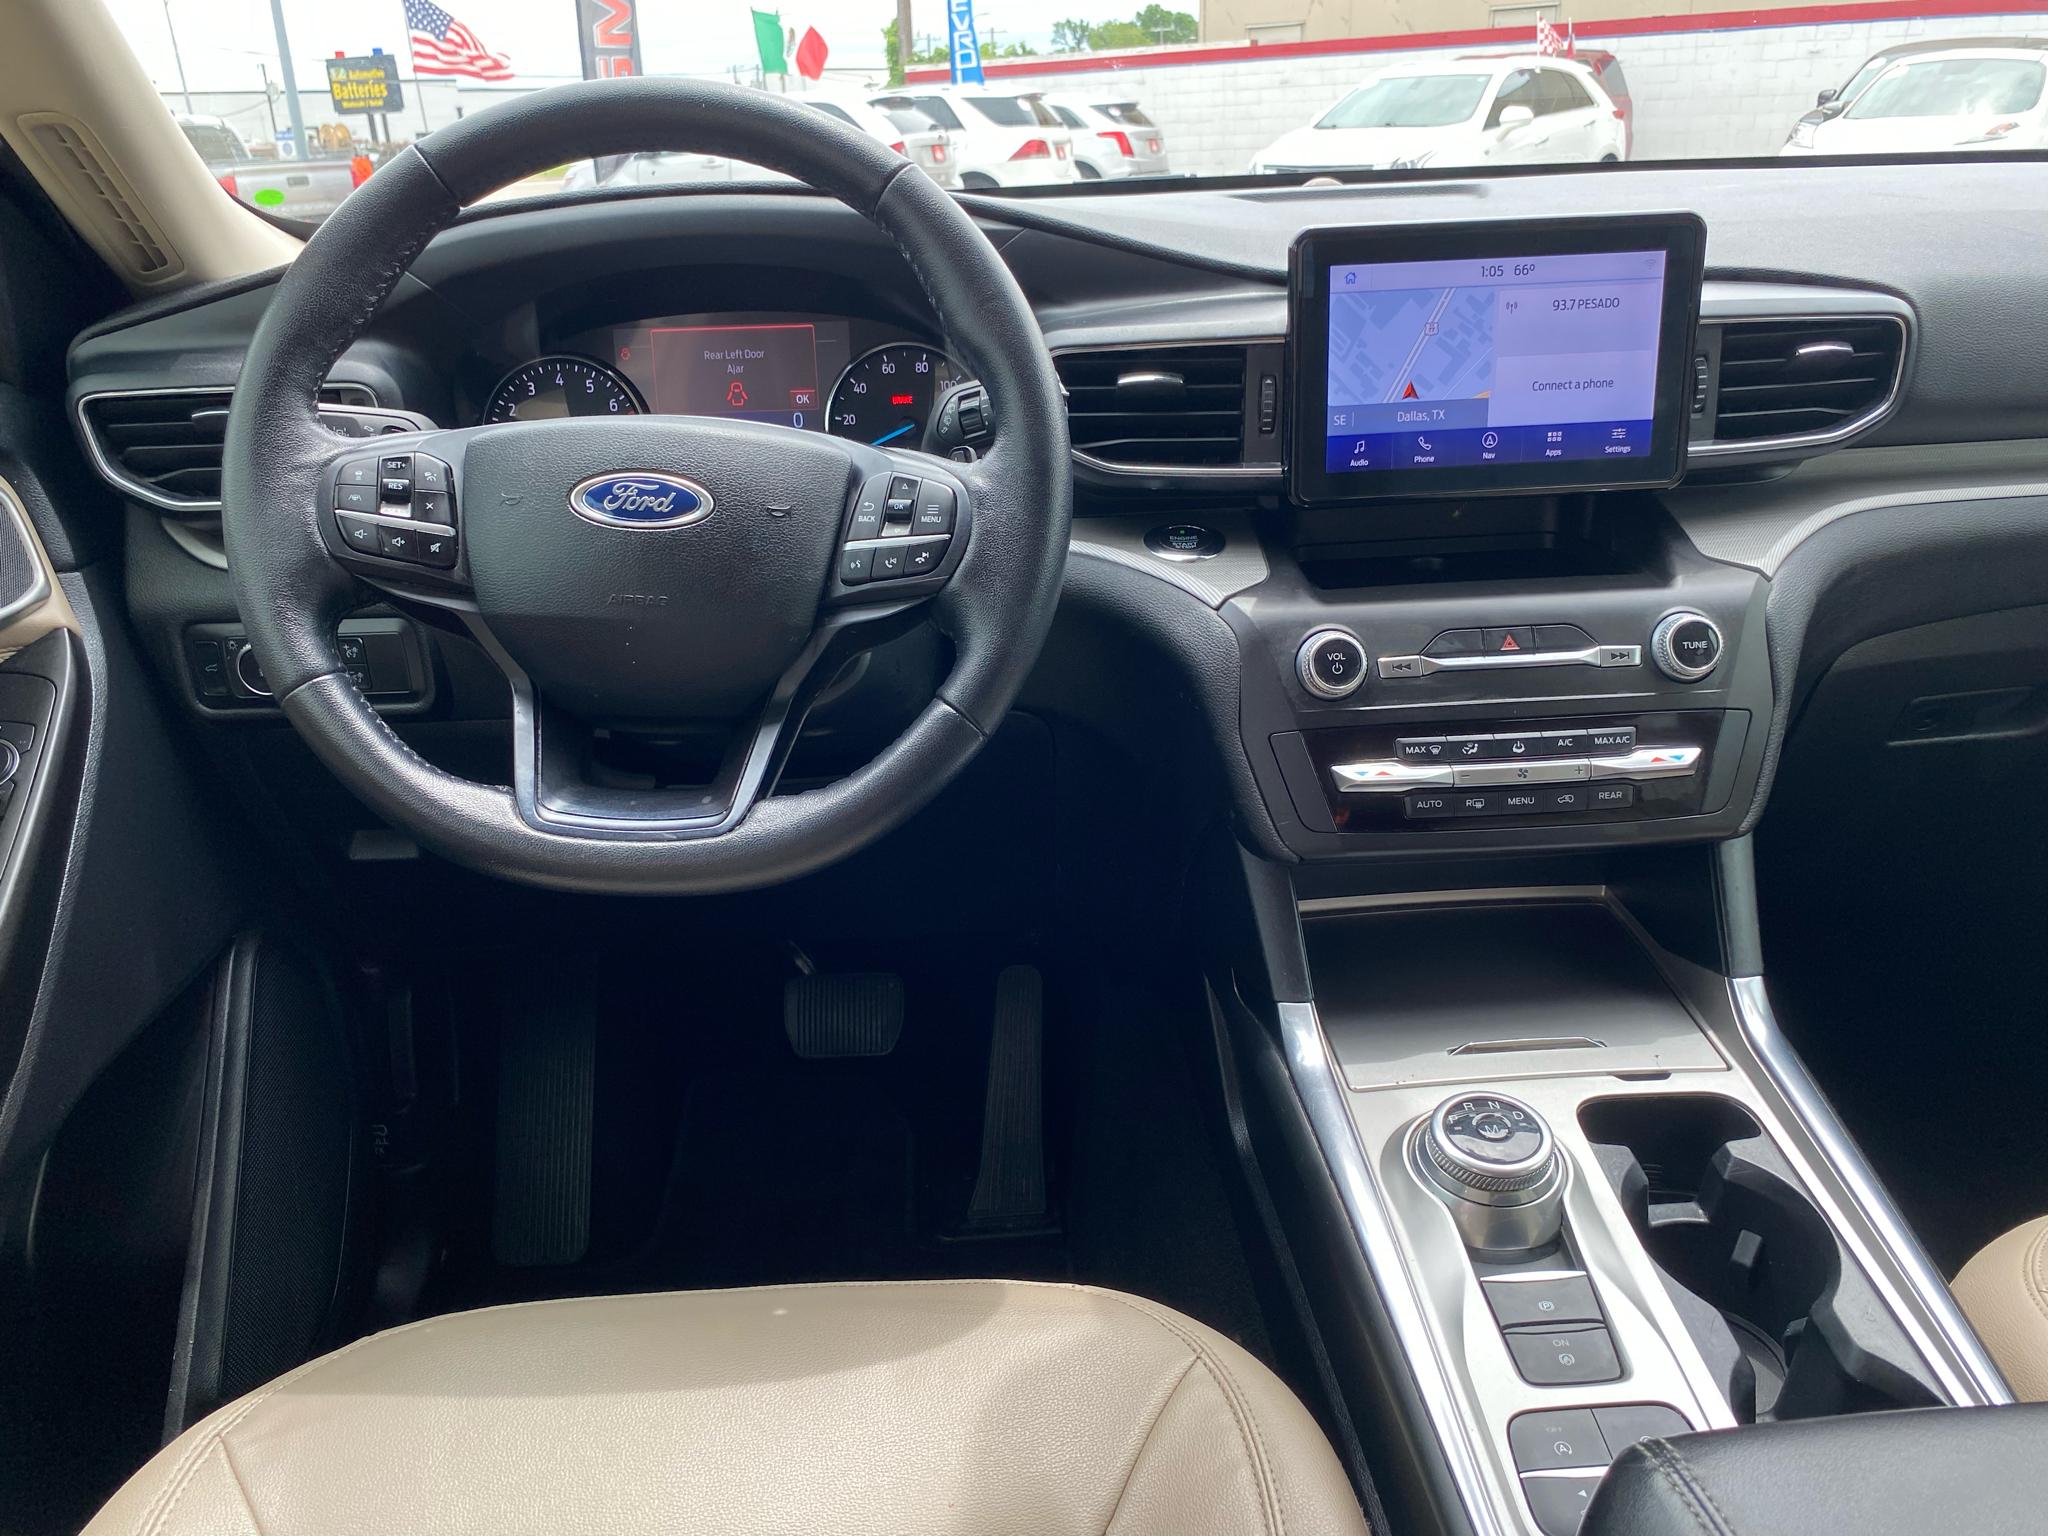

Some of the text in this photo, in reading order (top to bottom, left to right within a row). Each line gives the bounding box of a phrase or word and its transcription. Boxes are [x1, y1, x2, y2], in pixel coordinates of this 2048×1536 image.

[332, 81, 388, 100] Batteries
[1481, 265, 1504, 277] 1:05
[1552, 297, 1620, 311] 93.7 PESADO
[704, 349, 764, 360] Rear Left Door
[727, 364, 744, 374] Ajar
[882, 363, 895, 374] 60
[915, 362, 928, 373] 80
[555, 372, 564, 386] 4
[527, 382, 535, 396] 3
[586, 379, 594, 393] 5
[853, 383, 867, 394] 40
[1532, 381, 1573, 392] Connect
[1583, 379, 1614, 390] phone
[796, 395, 810, 404] OK
[508, 403, 517, 417] 2
[609, 399, 618, 412] 6
[793, 412, 804, 428] 0
[843, 414, 856, 425] 20
[1334, 415, 1347, 426] SE
[1397, 409, 1446, 423] Dallas, TX
[1482, 452, 1496, 460] Nav
[1545, 449, 1562, 457] Apps
[1604, 446, 1632, 455] Settings
[387, 461, 406, 469] SET+
[1350, 459, 1369, 468] Audio
[1414, 456, 1435, 464] Phone
[603, 482, 676, 513] Ford
[1682, 641, 1708, 649] TUNE
[1594, 736, 1630, 745] MAX A/C
[1405, 746, 1426, 754] MAX
[1417, 800, 1442, 809] AUTO
[1508, 797, 1535, 805] MENU
[1448, 1101, 1524, 1124] P R N D
[1484, 1125, 1499, 1135] M
[1553, 1339, 1570, 1347] ON
